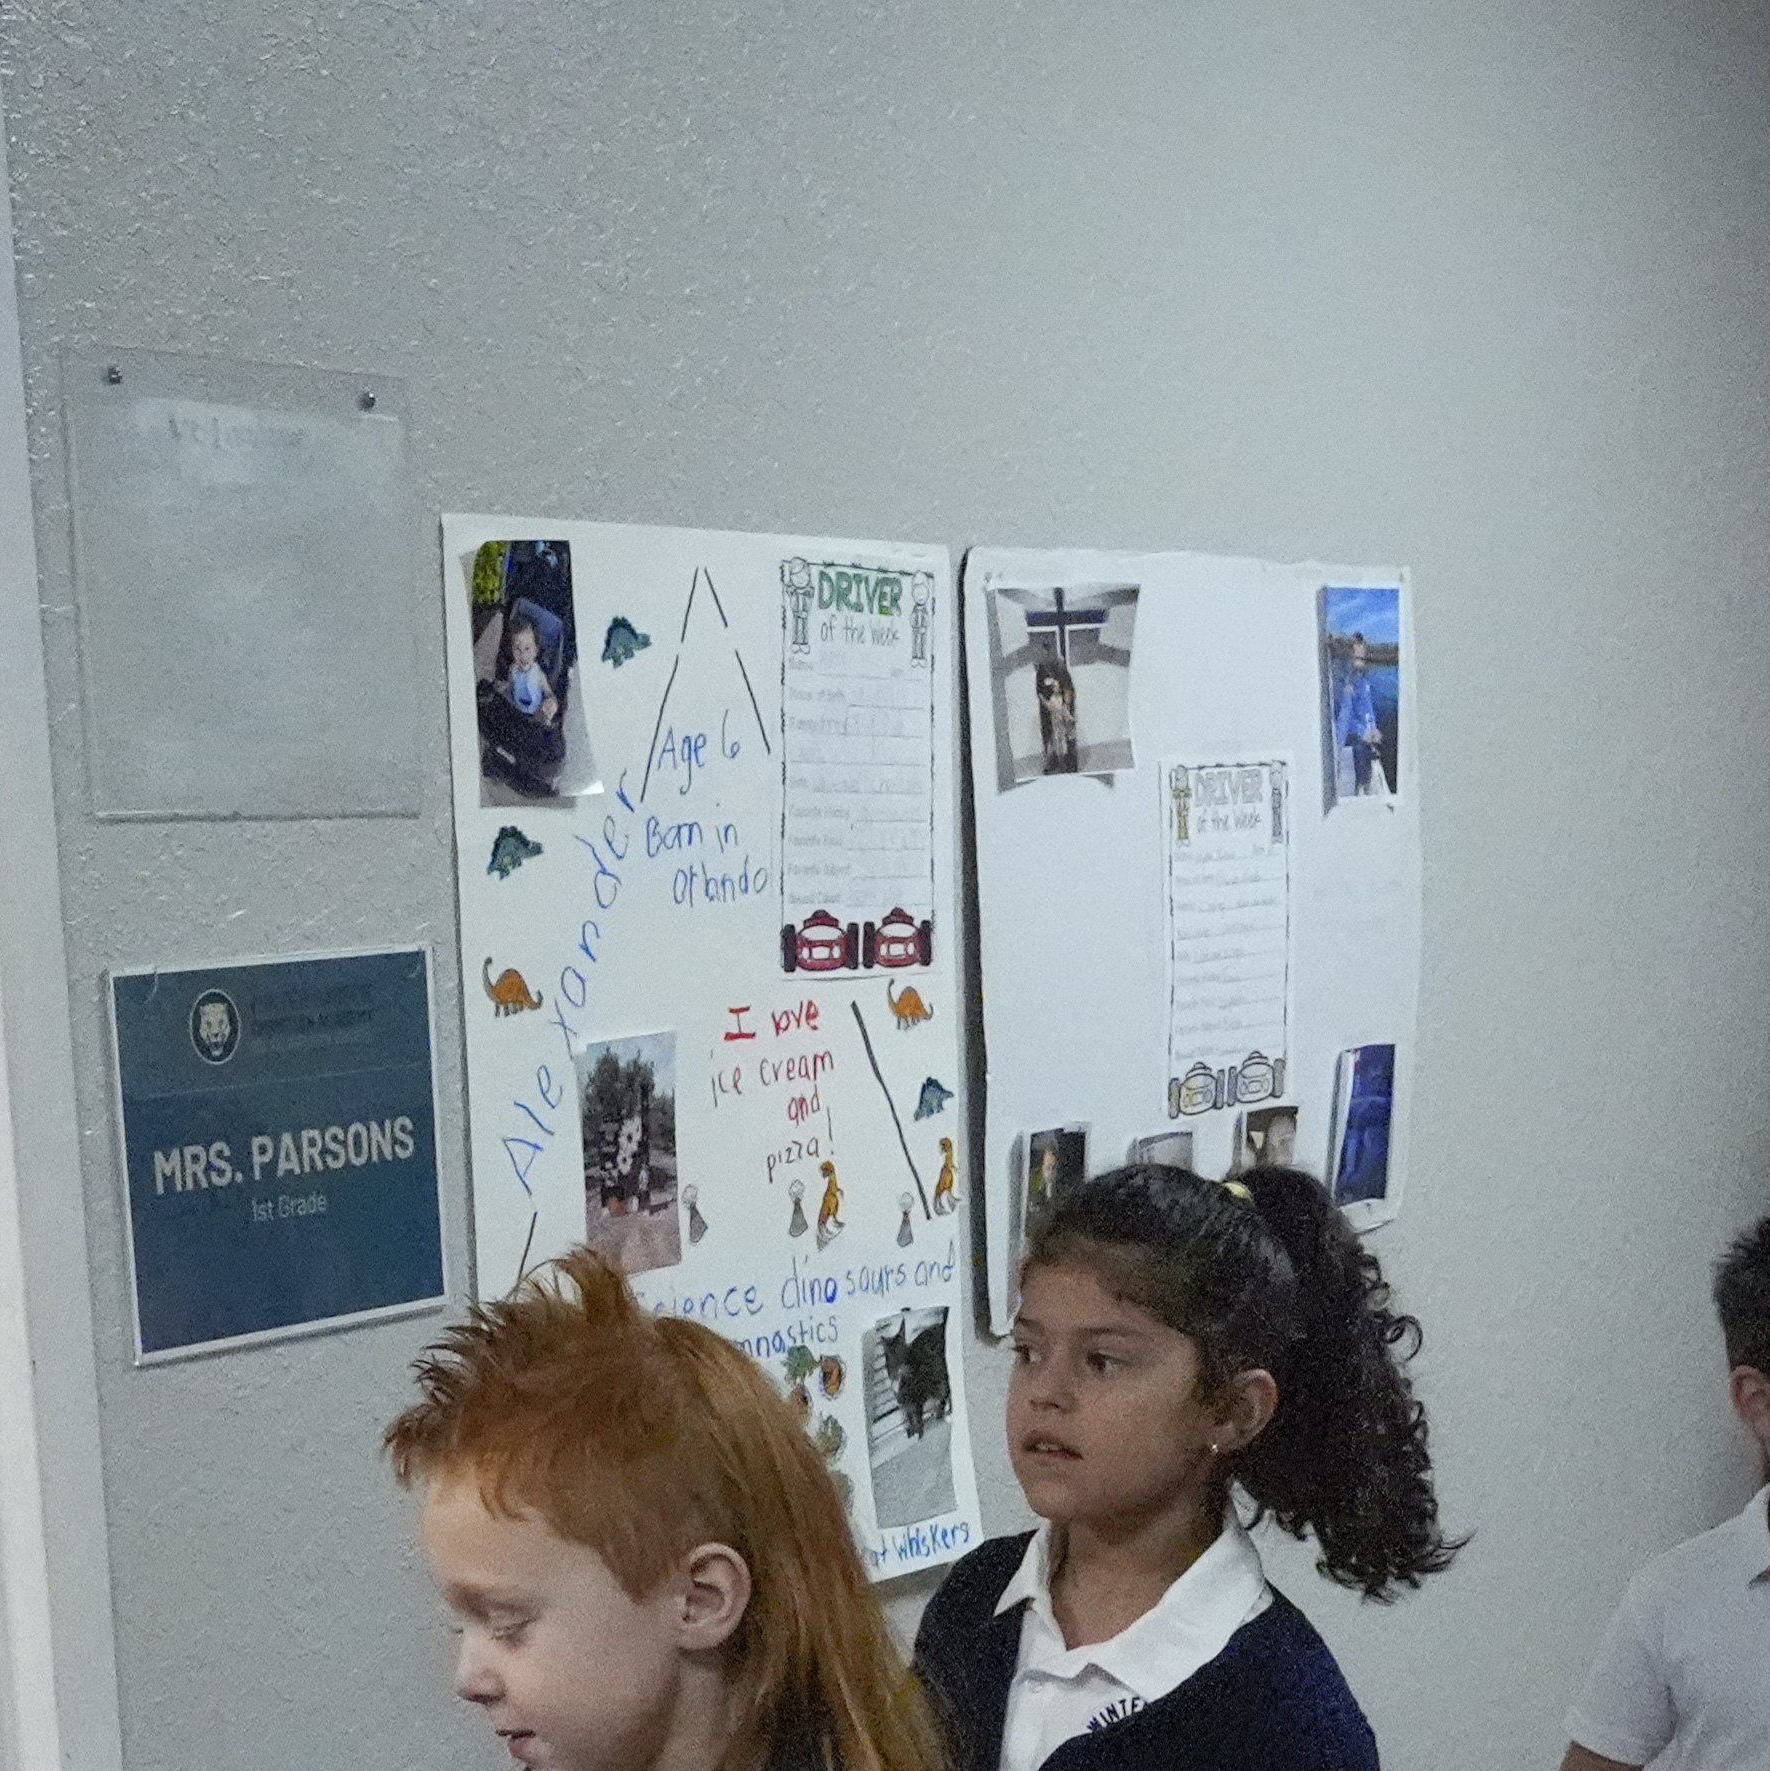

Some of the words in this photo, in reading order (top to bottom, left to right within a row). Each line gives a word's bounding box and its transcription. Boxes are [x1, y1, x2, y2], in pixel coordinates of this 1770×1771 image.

[818, 570, 903, 617] DRIVER
[820, 613, 838, 642] of
[843, 615, 866, 646] the
[656, 725, 707, 796] Age
[721, 708, 741, 759] 6
[1194, 768, 1264, 808] DRIVER
[646, 815, 704, 858] Born
[715, 802, 739, 854] in
[723, 1004, 757, 1041] I
[771, 999, 820, 1038] love
[710, 1049, 743, 1108] ice
[759, 1050, 835, 1087] cream
[788, 1083, 821, 1127] and
[153, 1140, 243, 1196] MRS.
[249, 1115, 416, 1182] PARSONS
[252, 1199, 275, 1223] 1st
[279, 1190, 328, 1219] Grade
[914, 1237, 956, 1287] and
[1087, 1696, 1149, 1733] WINTE
